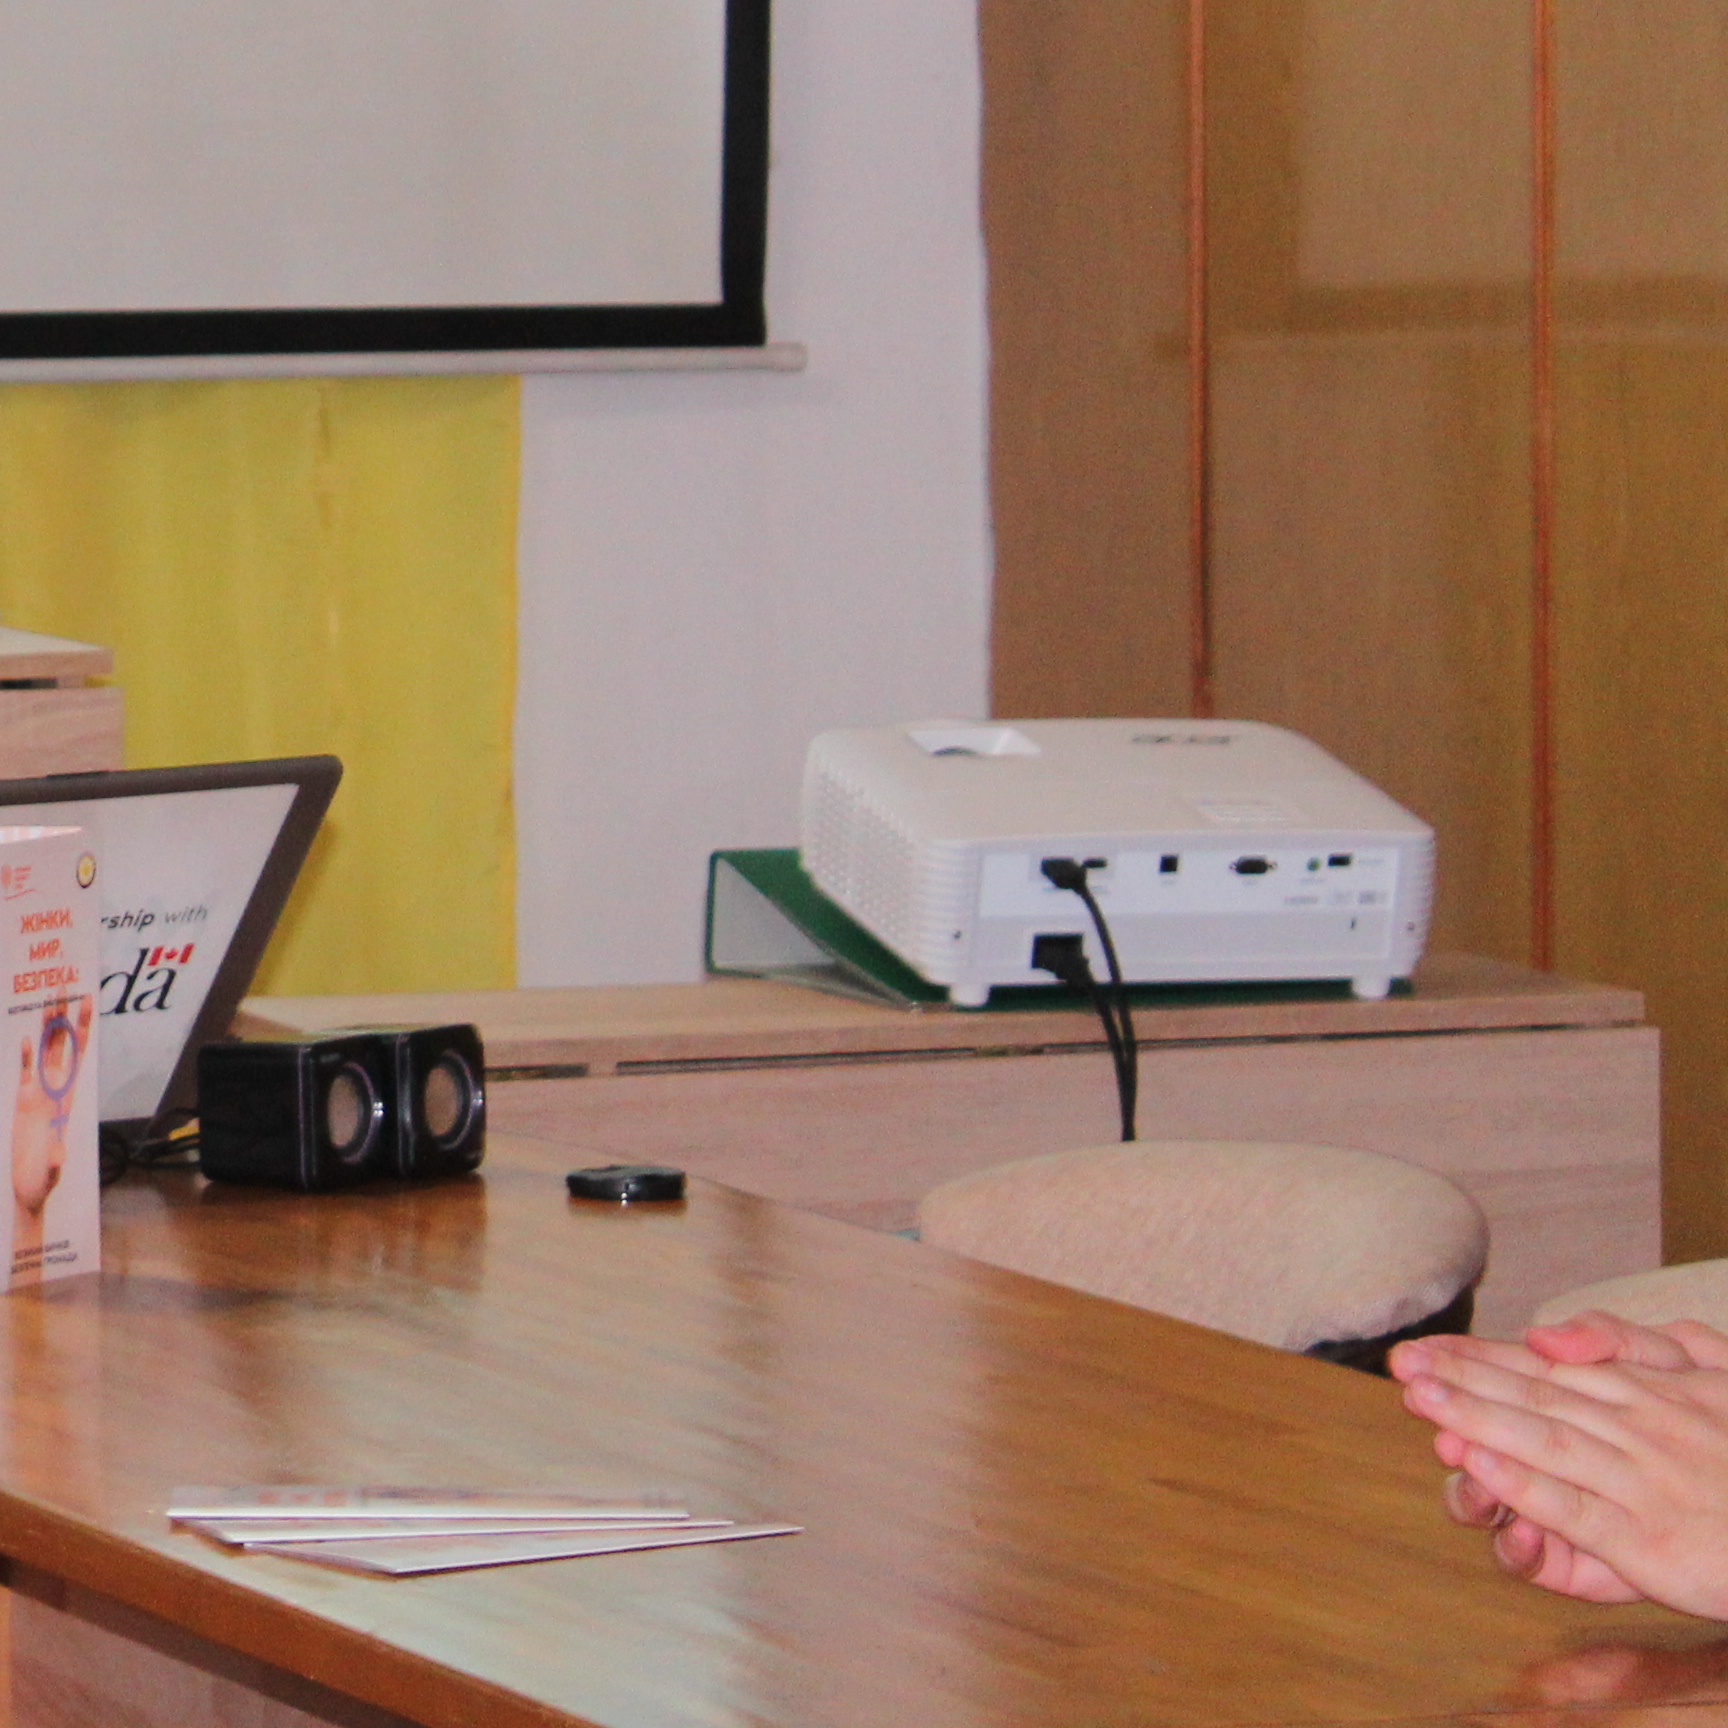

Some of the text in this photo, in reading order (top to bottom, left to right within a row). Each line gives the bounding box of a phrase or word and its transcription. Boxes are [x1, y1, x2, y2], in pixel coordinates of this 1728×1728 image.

[101, 905, 208, 932] rship with
[101, 947, 178, 1016] da
